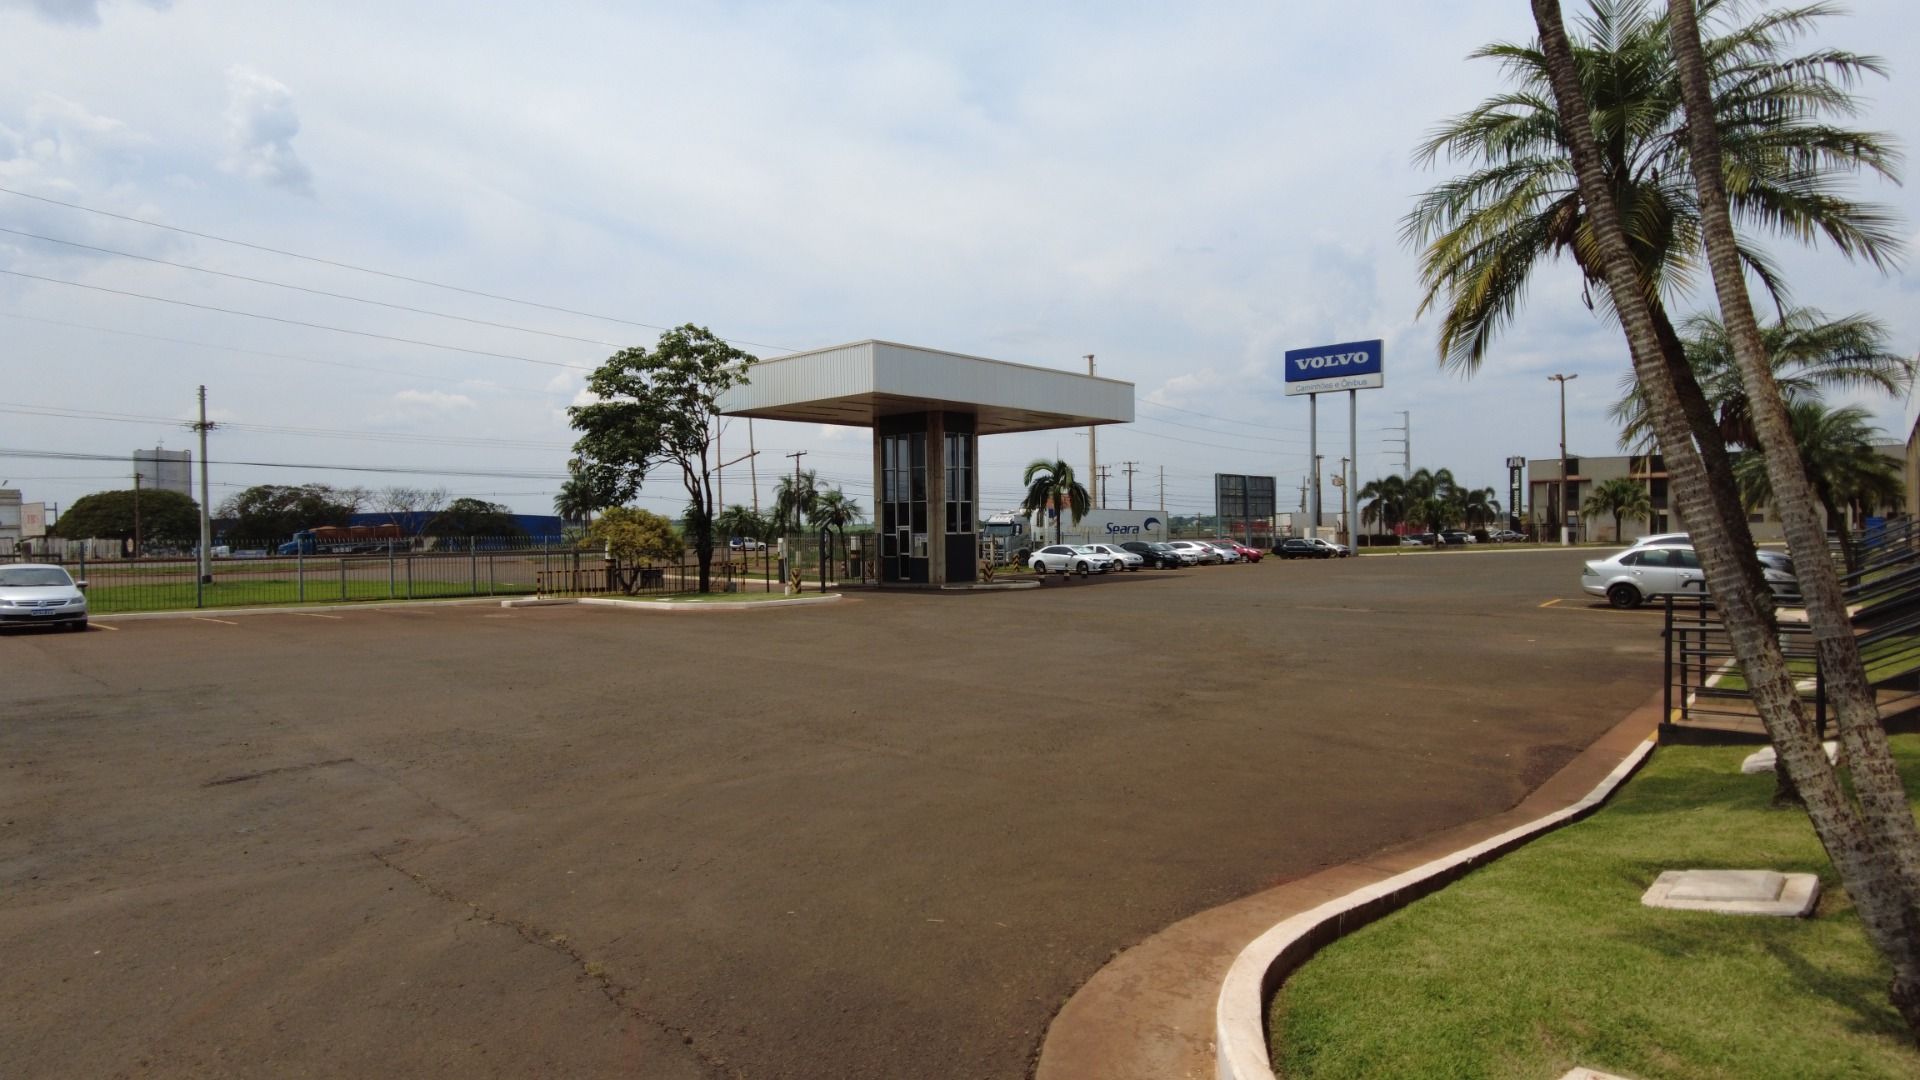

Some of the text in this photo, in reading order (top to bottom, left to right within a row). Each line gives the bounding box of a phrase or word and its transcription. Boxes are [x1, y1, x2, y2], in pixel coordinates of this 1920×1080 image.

[1295, 351, 1369, 370] VOLVO
[1295, 382, 1333, 392] Caminhões
[1341, 378, 1367, 387] Ônibus
[1105, 522, 1140, 534] Seara
